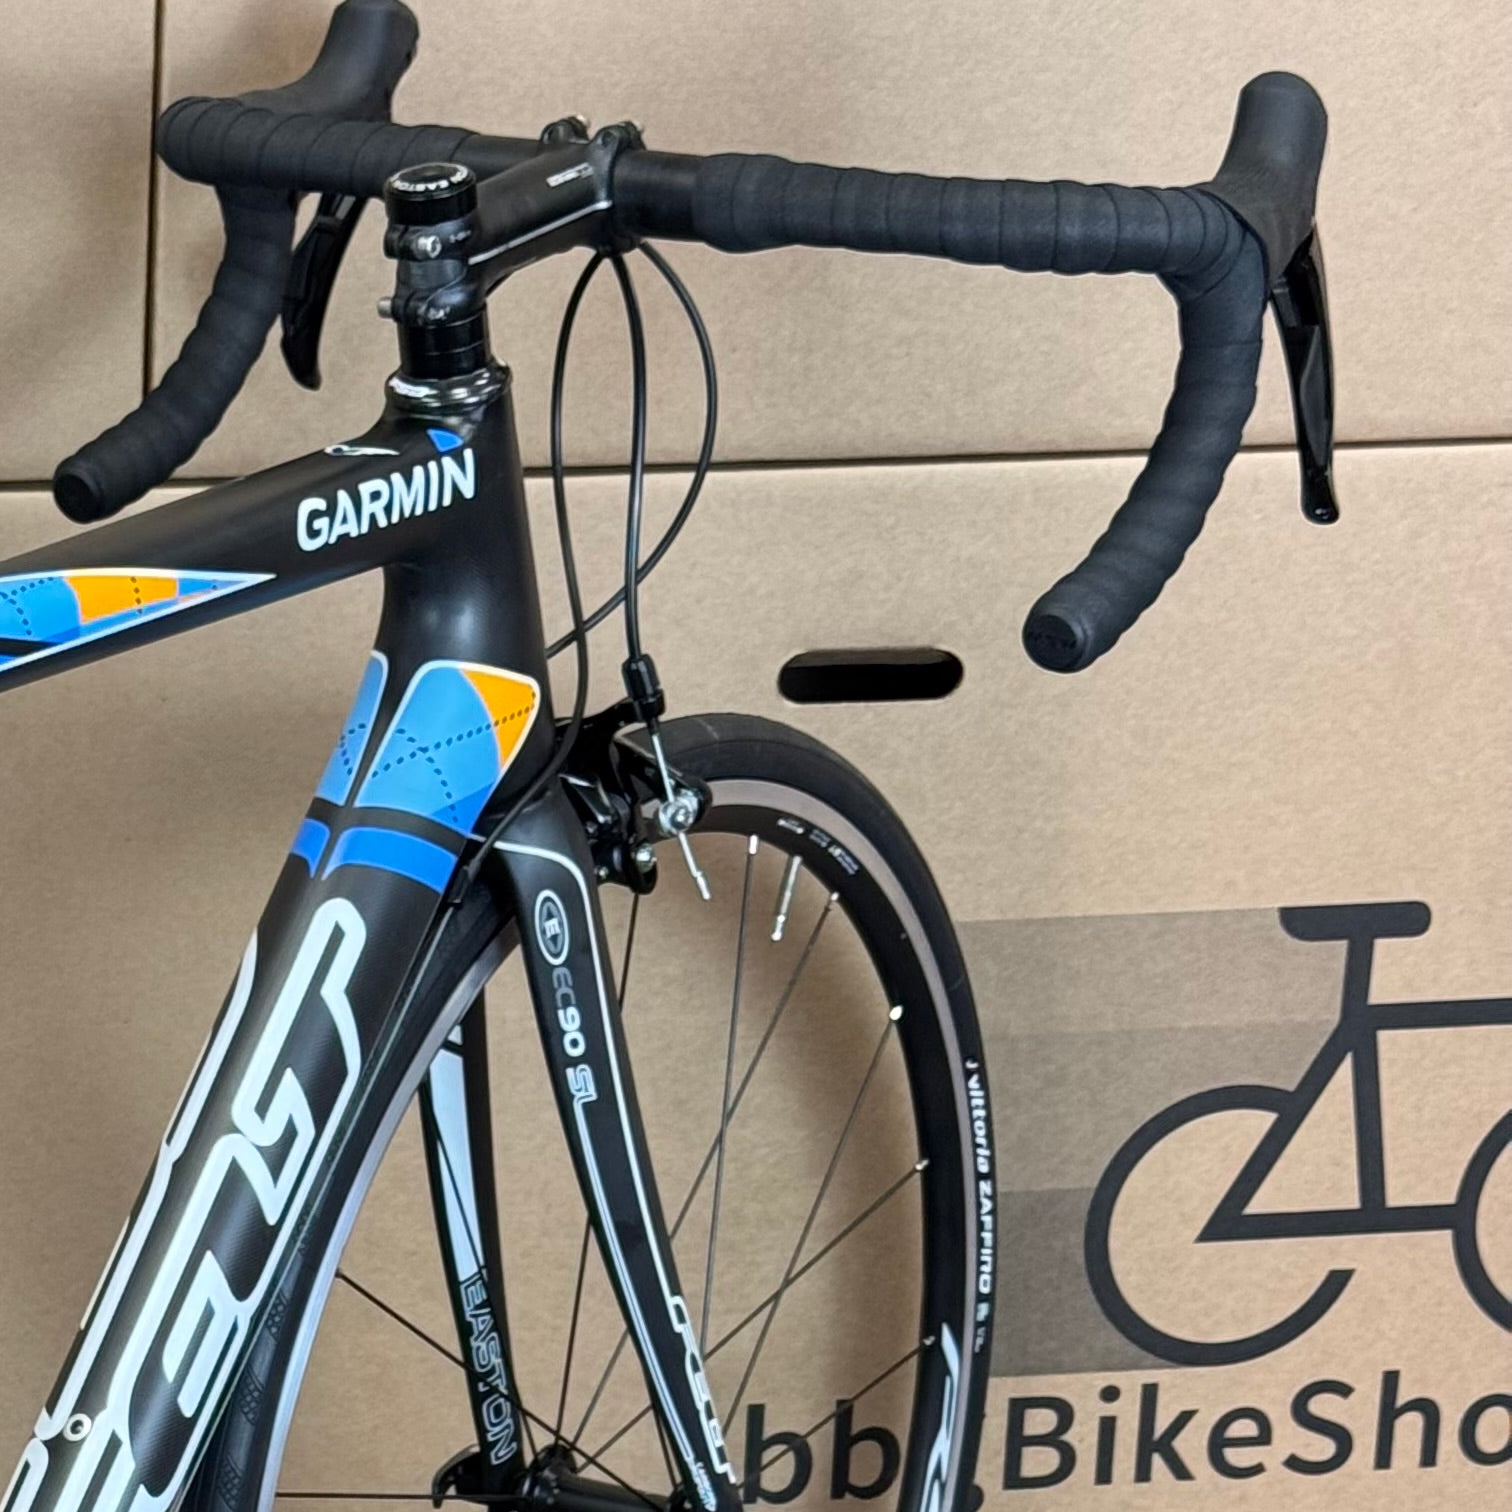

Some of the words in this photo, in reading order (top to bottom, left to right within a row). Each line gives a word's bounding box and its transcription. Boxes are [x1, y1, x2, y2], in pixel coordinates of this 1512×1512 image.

[296, 448, 476, 552] GARMIN
[969, 1077, 991, 1175] vittoria
[978, 1184, 994, 1295] ZAFFIRO
[461, 1271, 518, 1465] EASTON
